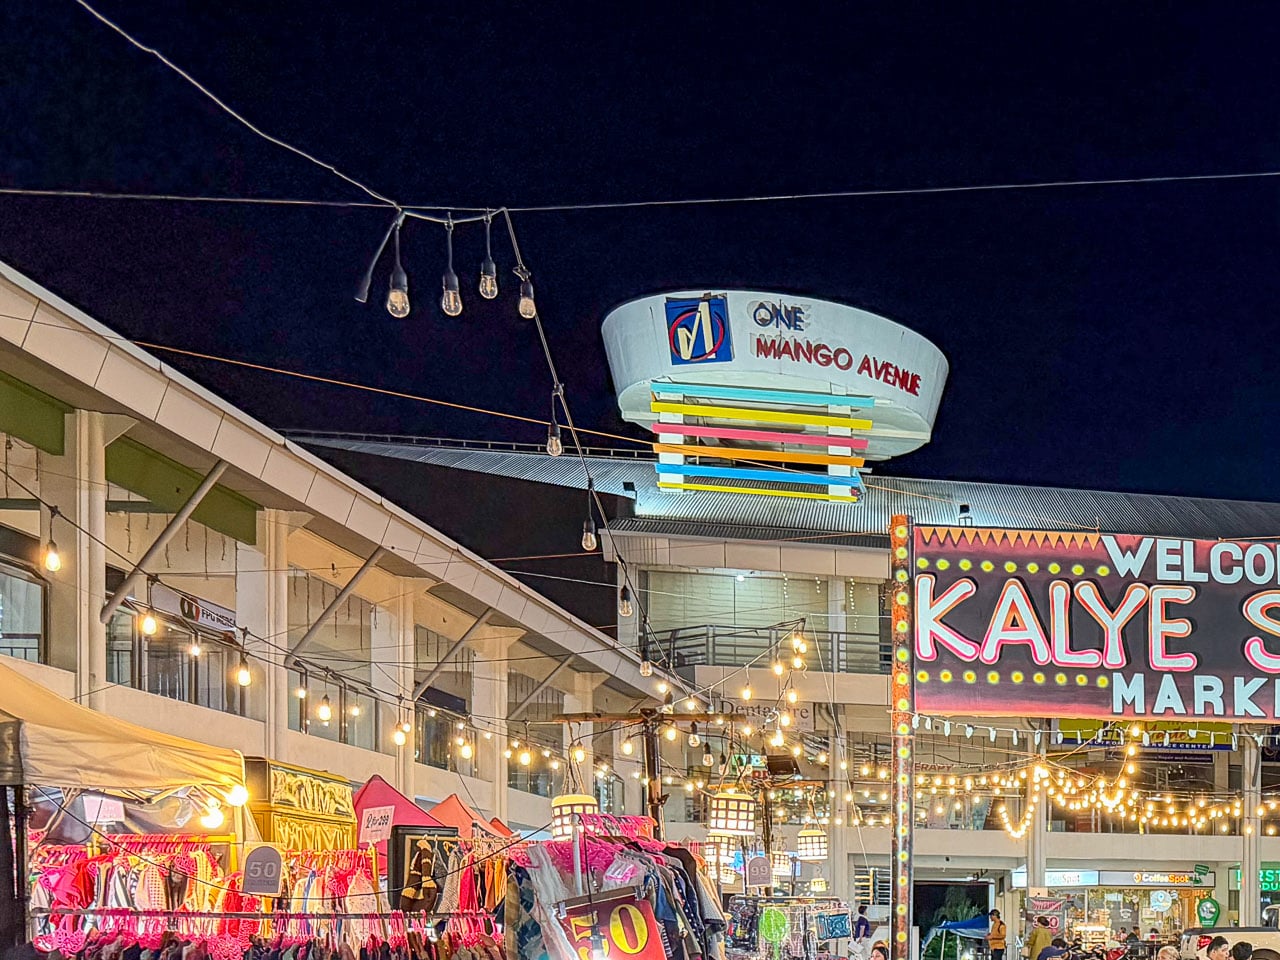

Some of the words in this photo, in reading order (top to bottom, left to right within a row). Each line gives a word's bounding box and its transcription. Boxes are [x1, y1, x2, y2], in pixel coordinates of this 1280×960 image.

[753, 303, 805, 331] ONE
[756, 336, 853, 371] MANGO
[857, 354, 922, 398] AVENUE
[914, 574, 1198, 671] KALYE
[249, 861, 277, 878] 50
[751, 865, 769, 876] 99
